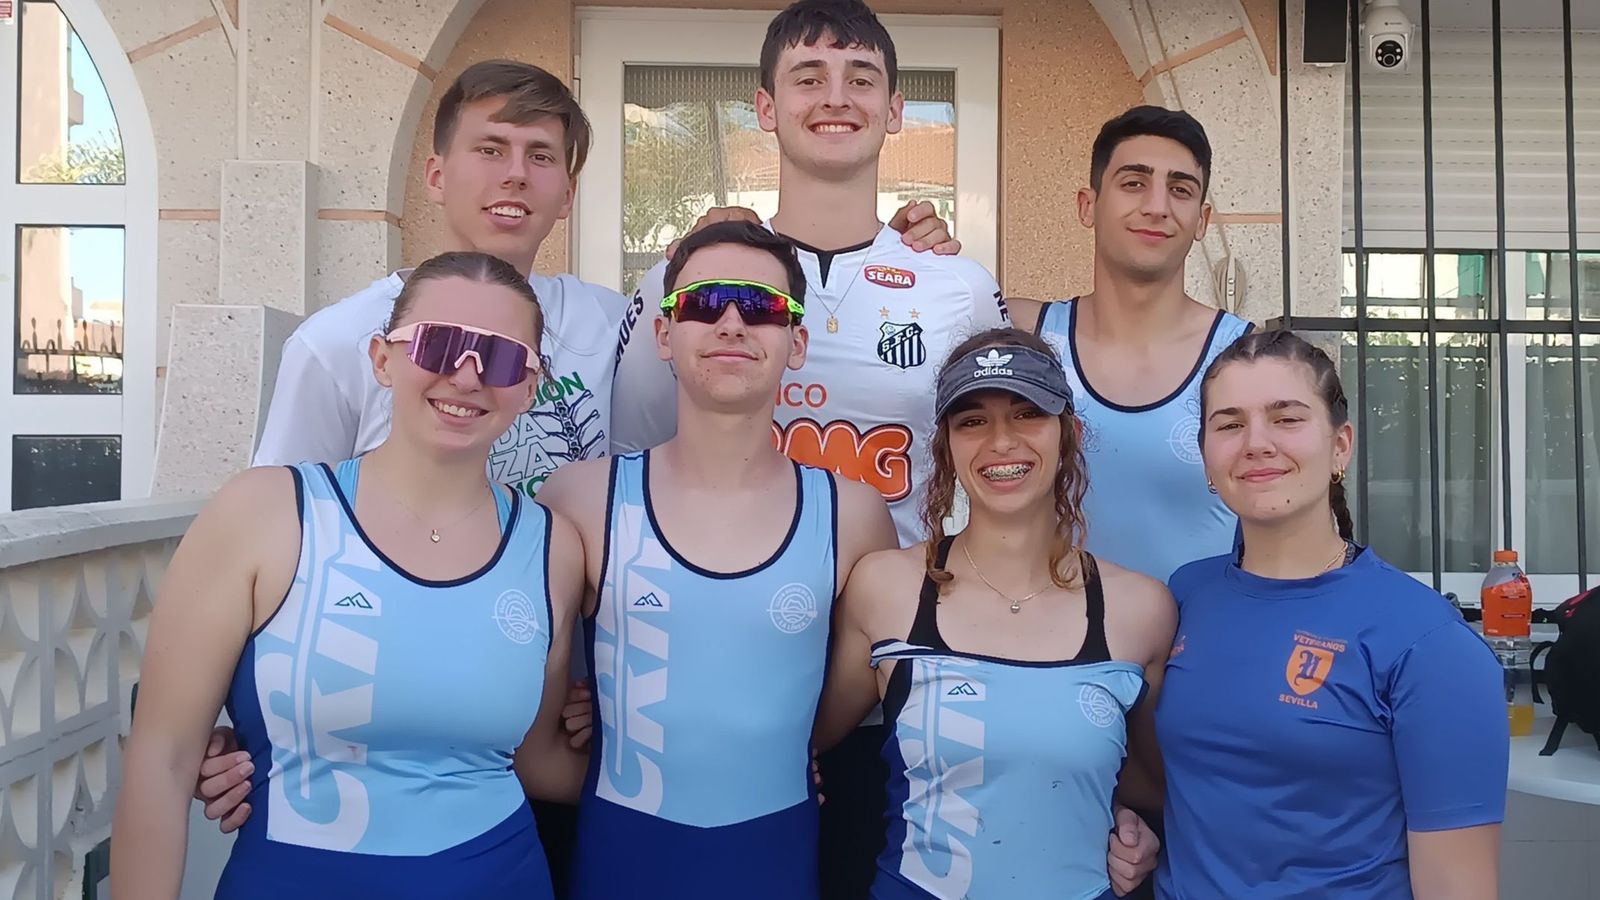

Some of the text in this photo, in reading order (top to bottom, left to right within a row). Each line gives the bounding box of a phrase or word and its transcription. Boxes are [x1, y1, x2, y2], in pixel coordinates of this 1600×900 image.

[868, 270, 912, 286] SEARA
[974, 367, 1013, 378] adidas
[530, 371, 585, 409] ION
[1278, 693, 1318, 710] SEVILLA
